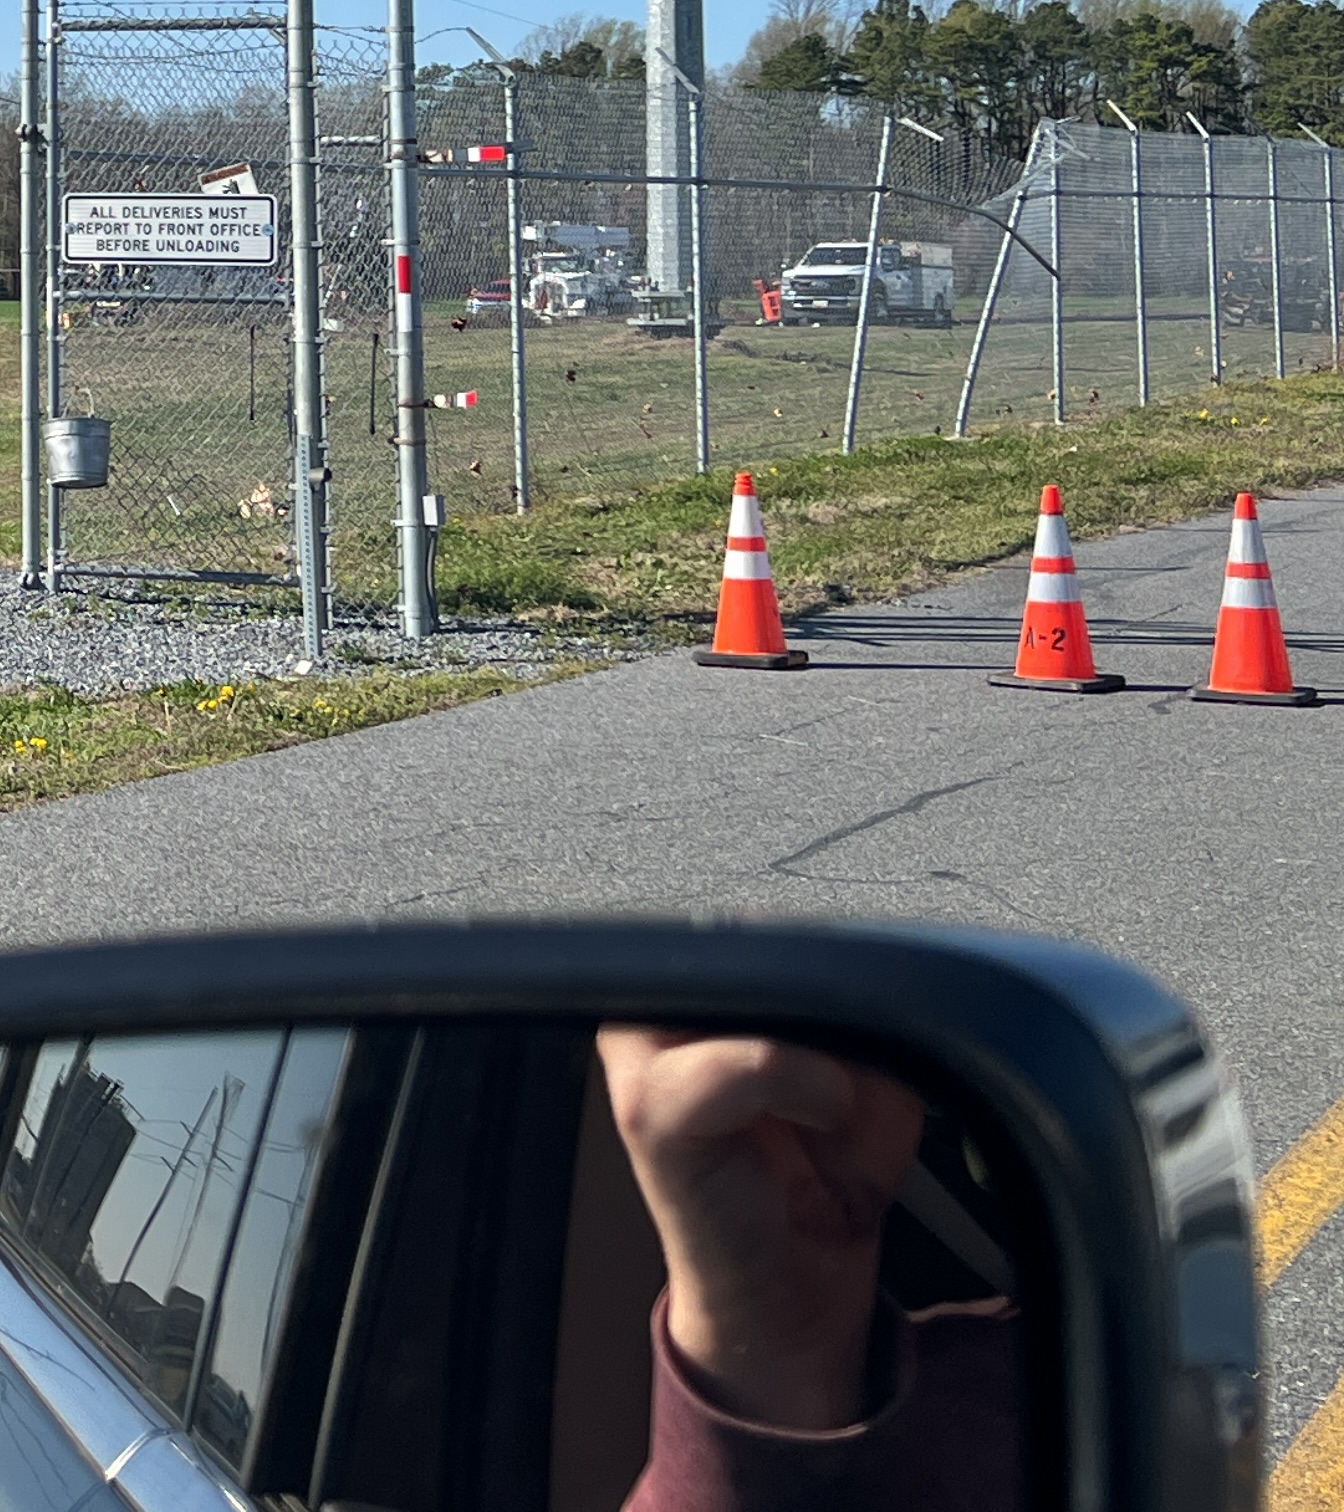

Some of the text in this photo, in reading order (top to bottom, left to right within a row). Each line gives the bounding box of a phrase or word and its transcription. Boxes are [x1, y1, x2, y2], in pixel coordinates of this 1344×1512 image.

[89, 206, 248, 220] ALL DELIVERIES MUST
[77, 222, 261, 237] REPORT TO FRONT OFFICE
[96, 239, 241, 253] BEFORE UNLOADING
[1023, 626, 1067, 652] A-2
